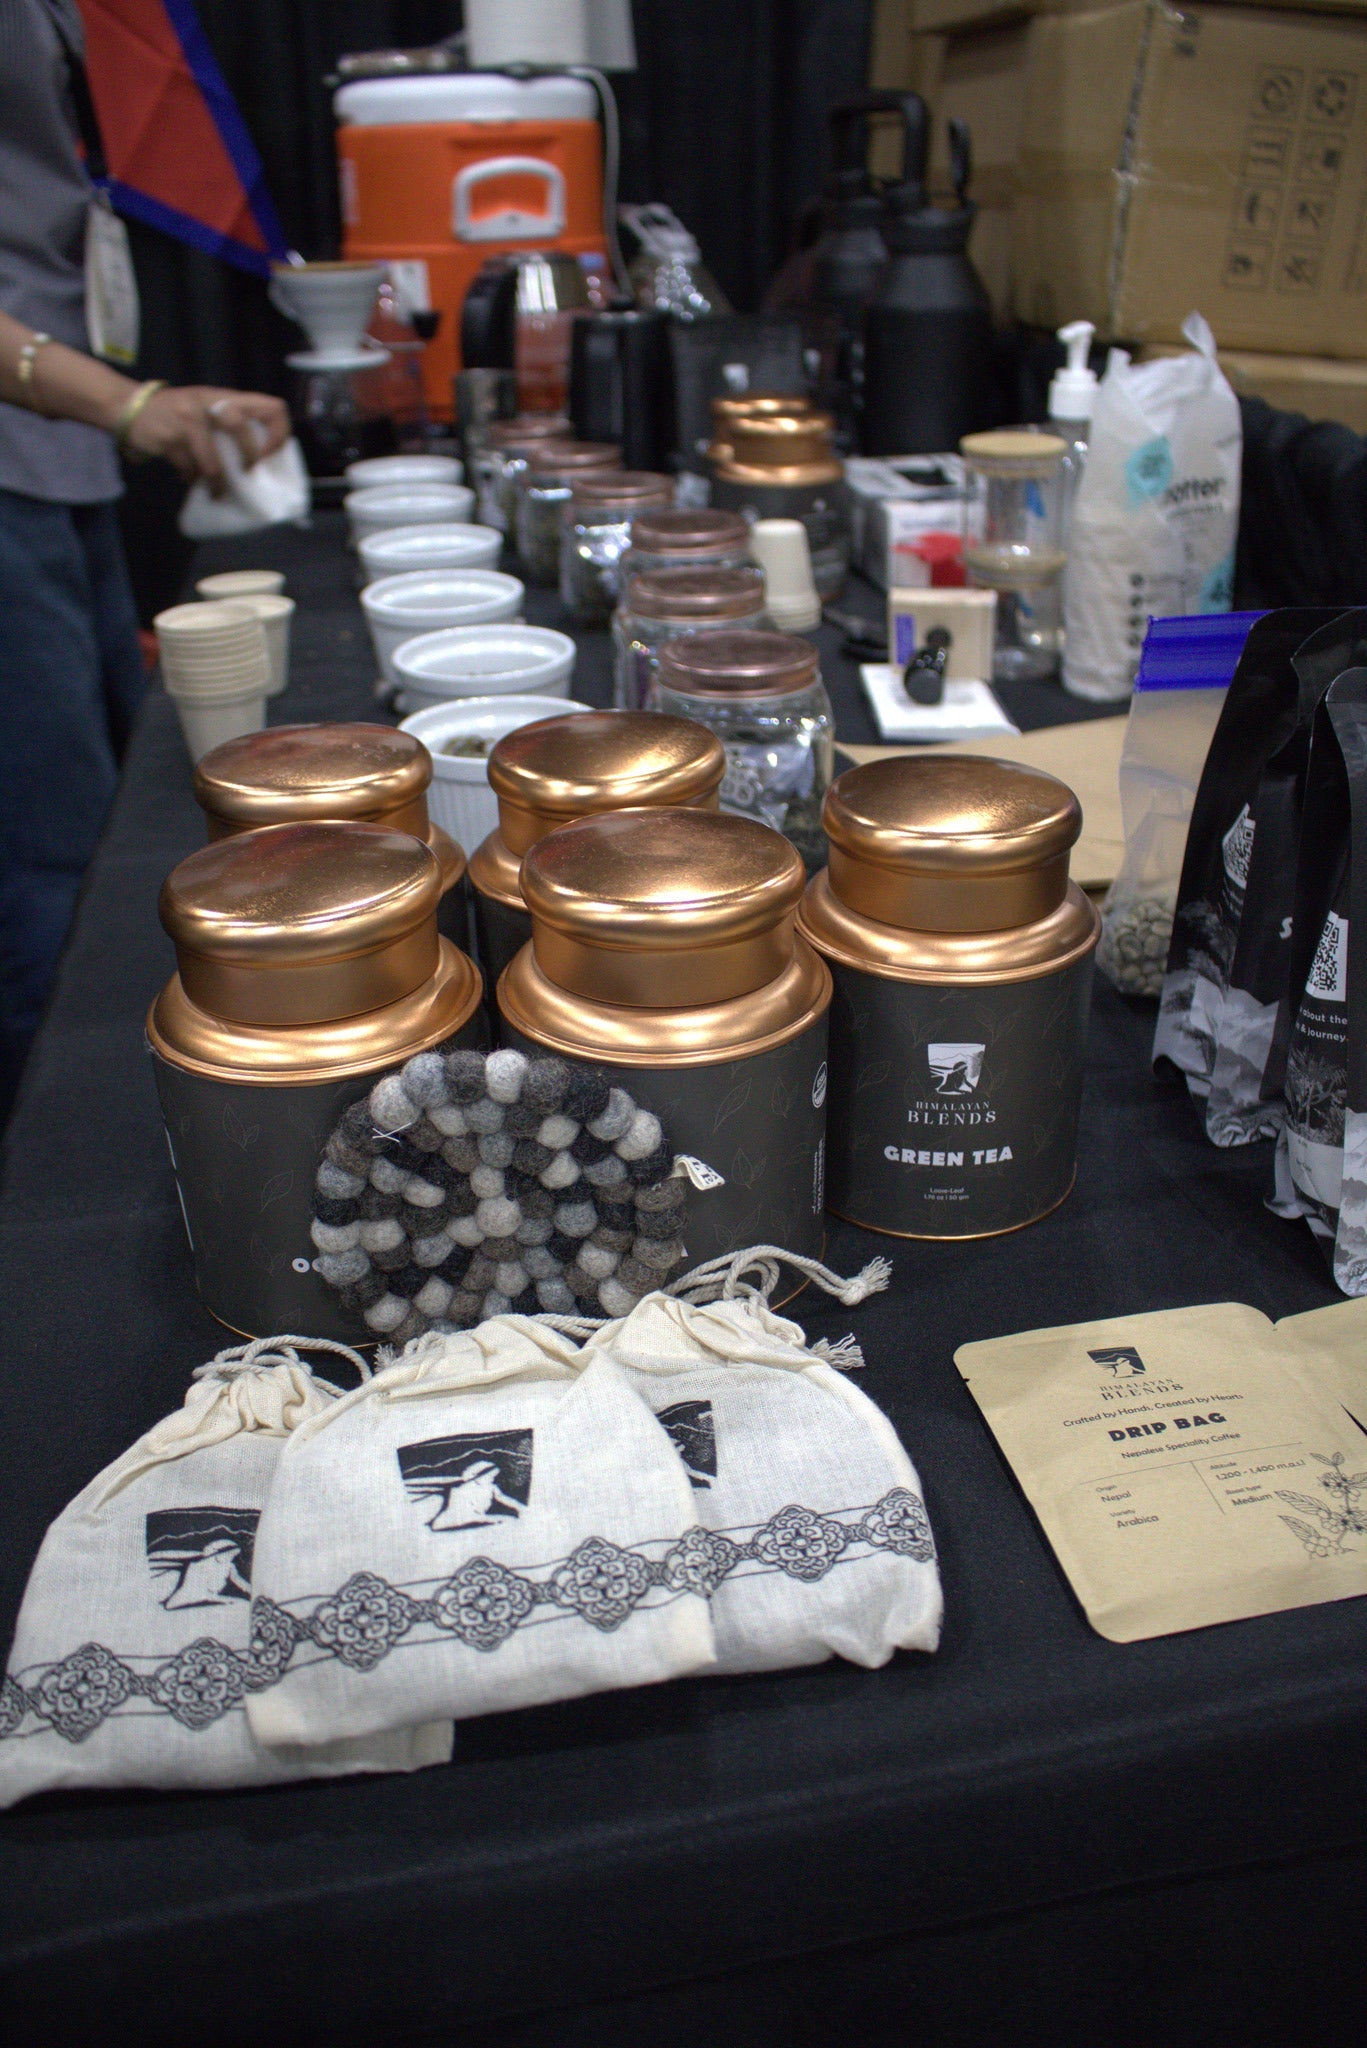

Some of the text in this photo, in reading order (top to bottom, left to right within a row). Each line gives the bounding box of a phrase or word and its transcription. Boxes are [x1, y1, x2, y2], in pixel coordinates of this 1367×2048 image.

[1302, 1007, 1326, 1022] about
[1329, 1014, 1348, 1025] the
[916, 1101, 990, 1111] HIMALAYAN
[908, 1110, 997, 1125] BLENDS
[884, 1145, 1013, 1167] GREEN TEA
[1100, 1377, 1174, 1392] HIMALAYAN
[1101, 1383, 1184, 1401] BLENDS
[1063, 1393, 1244, 1427] Crafted by Hands, Created by Hearts
[1108, 1412, 1227, 1442] DRIP BAG
[1121, 1432, 1242, 1459] Nepalese Speciality Coffee
[1101, 1490, 1132, 1502] Nepal
[1231, 1493, 1274, 1506] Medium
[1117, 1515, 1159, 1528] Arabica
